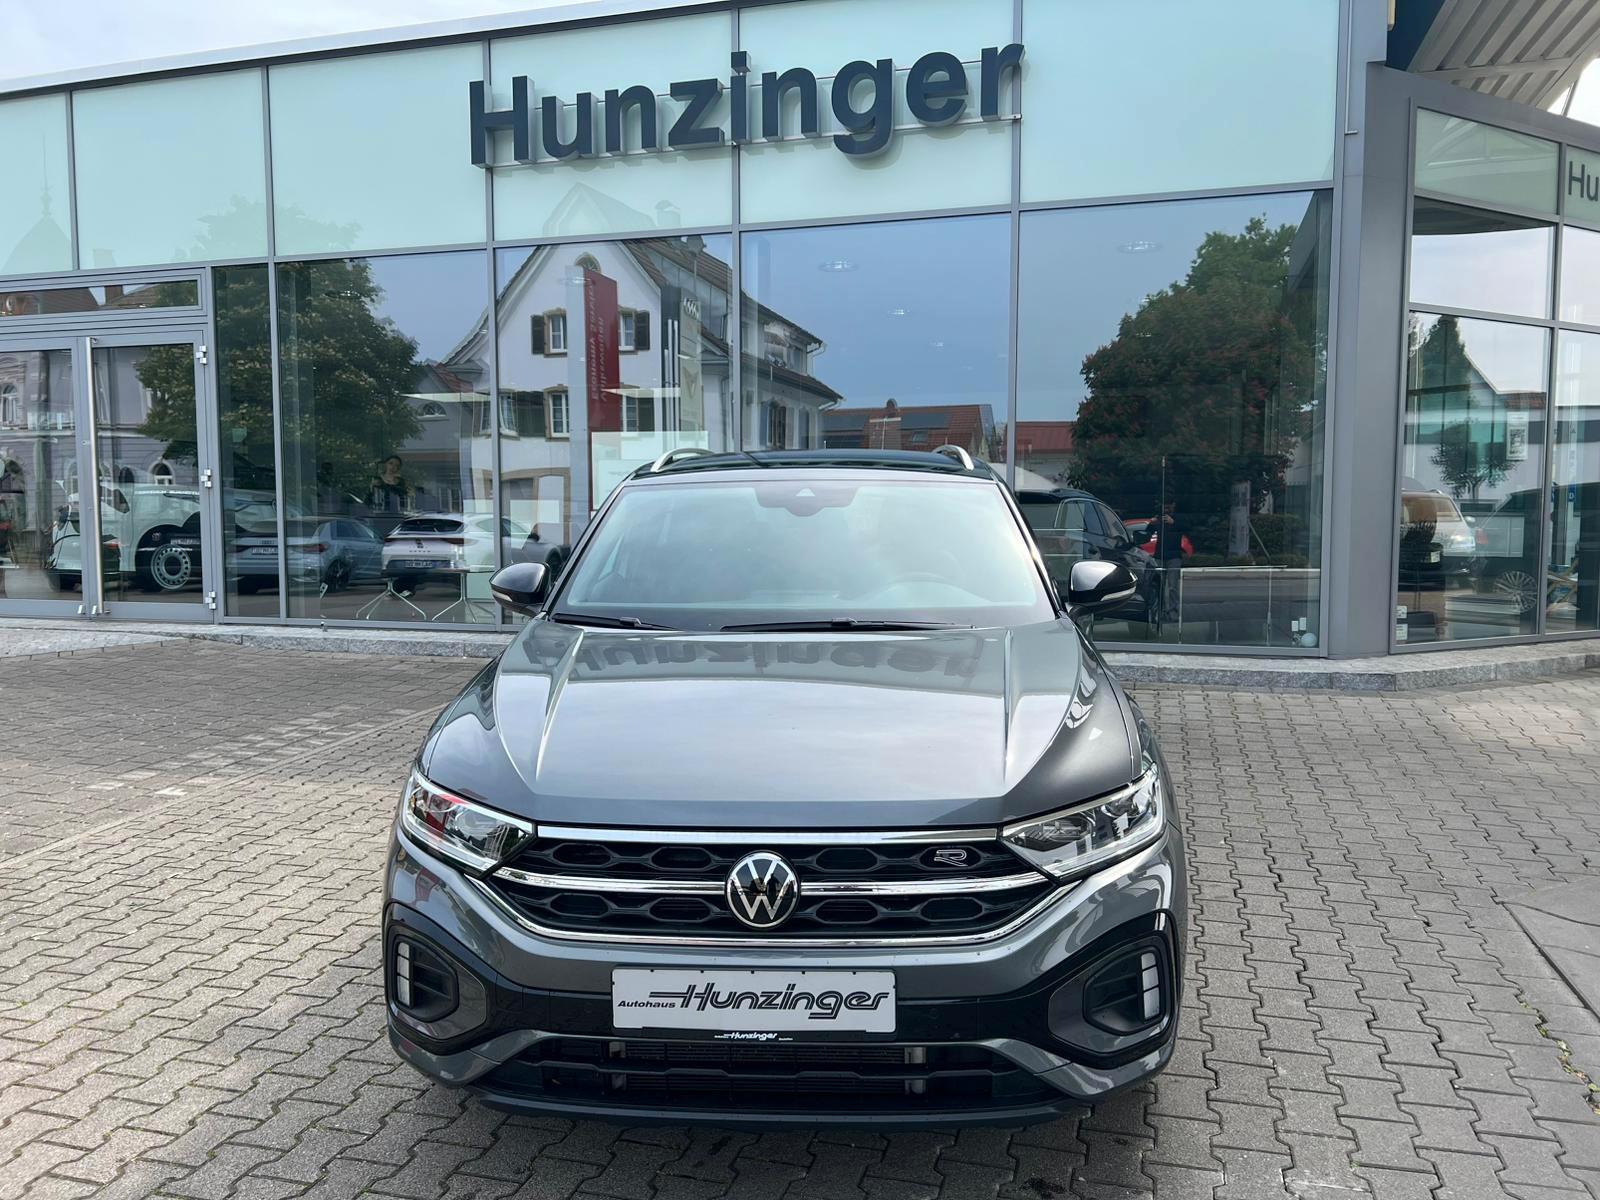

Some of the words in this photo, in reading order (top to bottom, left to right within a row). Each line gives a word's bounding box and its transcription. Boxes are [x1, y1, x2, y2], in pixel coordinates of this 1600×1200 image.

[469, 43, 1024, 168] Hunzinger
[728, 852, 797, 927] VW
[617, 999, 676, 1009] Autohaus
[648, 982, 890, 1020] Hunzinger
[724, 1031, 778, 1041] Hunzinger
